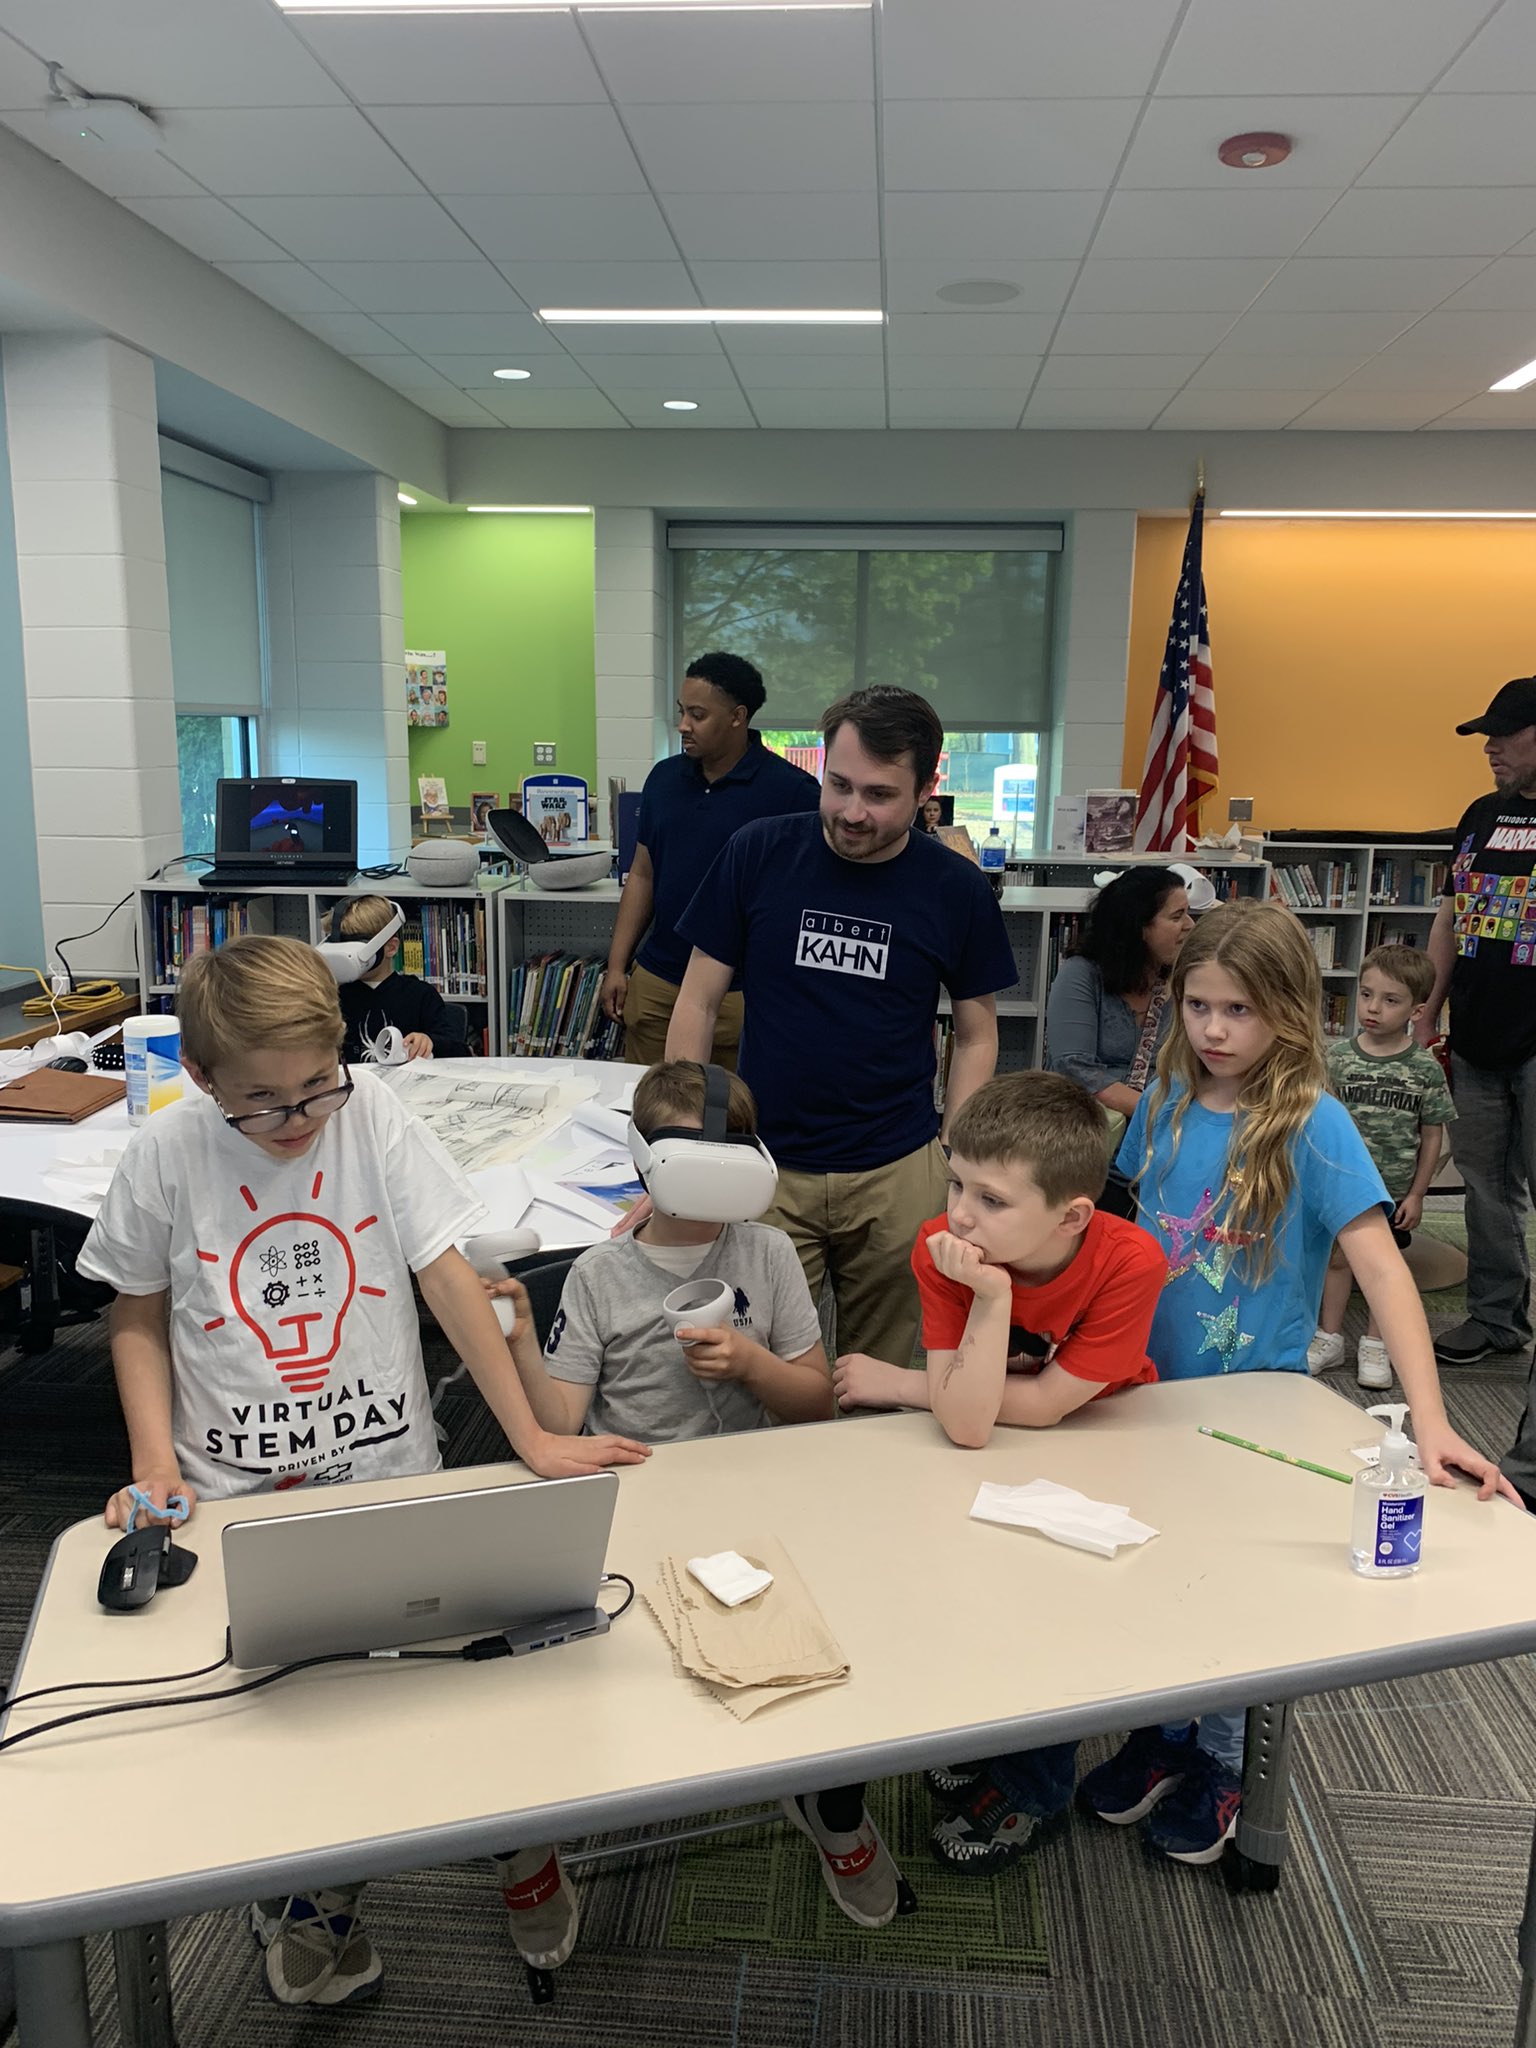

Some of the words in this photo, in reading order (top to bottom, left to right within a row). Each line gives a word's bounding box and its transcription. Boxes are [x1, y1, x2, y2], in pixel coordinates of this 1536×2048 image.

[541, 800, 567, 809] WARS
[1496, 815, 1528, 824] PERIODIC
[805, 917, 886, 941] albert
[800, 935, 884, 974] KAHN
[232, 1378, 374, 1426] VIRTUAL
[205, 1425, 316, 1459] STEM
[333, 1392, 407, 1439] DAY
[278, 1453, 326, 1473] DRIVEN
[331, 1445, 346, 1458] BY
[1381, 1506, 1404, 1514] Hand
[1381, 1513, 1416, 1522] Sanitizer
[1380, 1521, 1395, 1530] Gel
